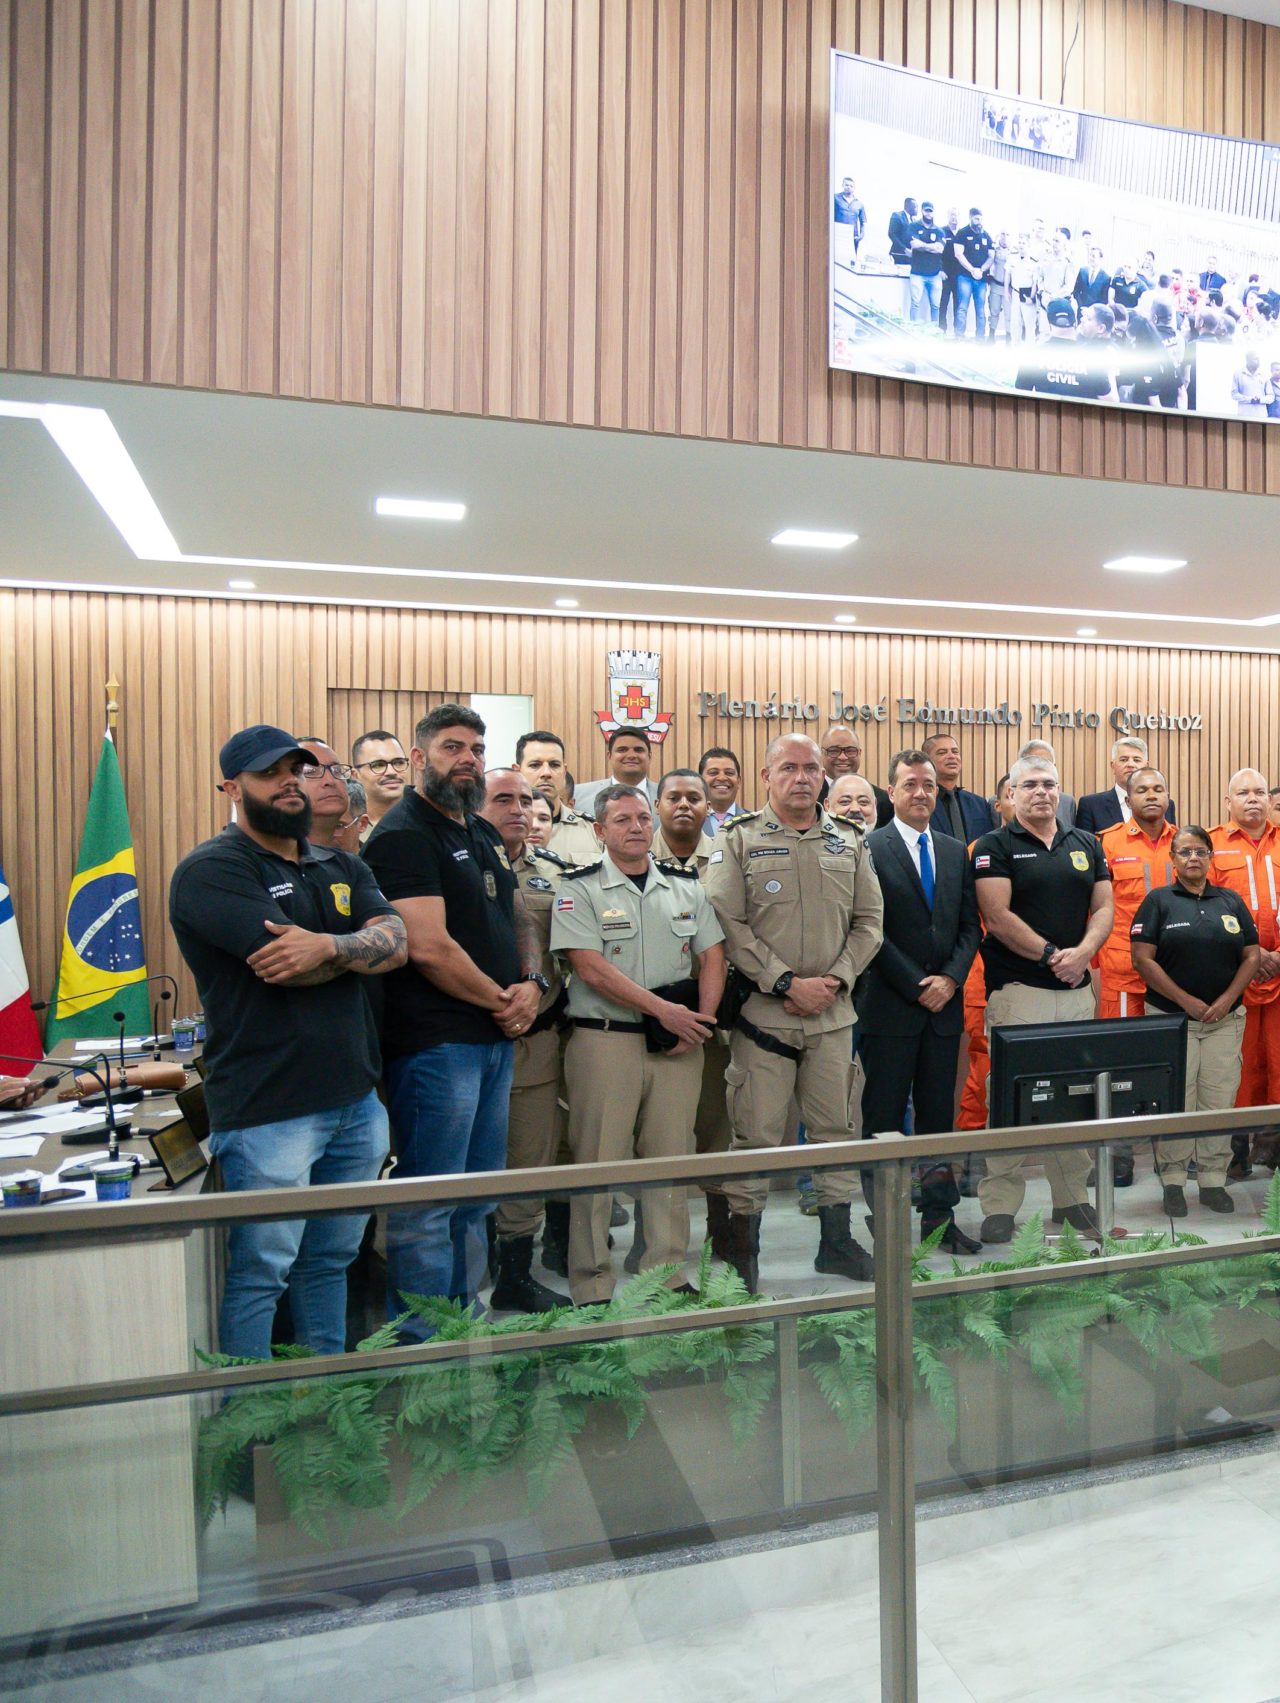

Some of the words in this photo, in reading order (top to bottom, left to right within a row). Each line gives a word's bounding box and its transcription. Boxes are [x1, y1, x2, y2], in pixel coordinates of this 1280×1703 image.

[1046, 371, 1080, 386] CIVIL
[624, 697, 646, 707] JHS
[697, 690, 820, 721] Plenário
[828, 690, 888, 722] José
[896, 698, 1022, 725] Edmundo
[1032, 703, 1100, 728] Pinto
[1109, 706, 1203, 735] Queiroz
